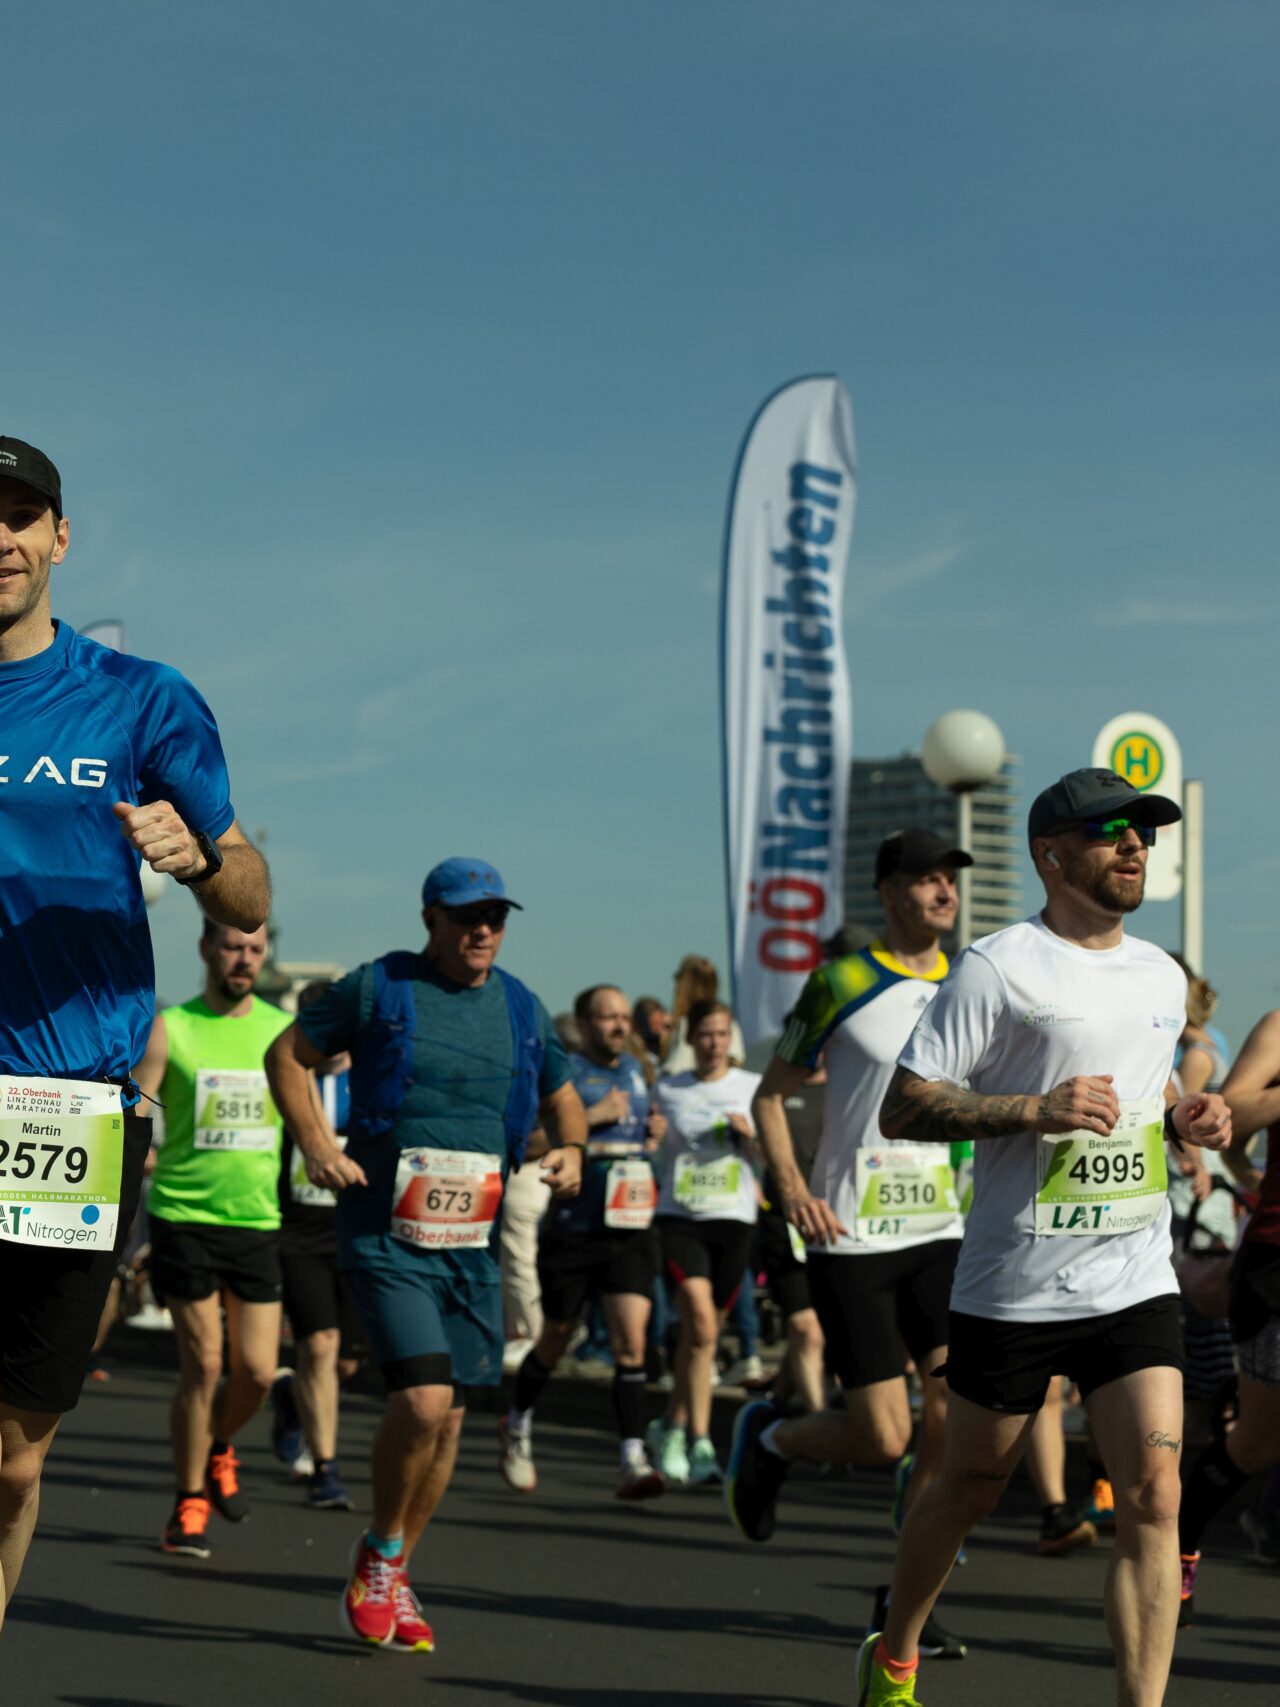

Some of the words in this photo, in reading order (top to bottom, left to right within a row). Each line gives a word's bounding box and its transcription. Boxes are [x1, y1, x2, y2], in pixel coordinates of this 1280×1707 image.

[1126, 746, 1149, 777] H
[23, 756, 108, 788] AG
[1032, 1014, 1055, 1025] ZMPT
[7, 1086, 21, 1096] 22.
[22, 1087, 62, 1099] Oberbank
[7, 1096, 26, 1104] LINZ
[30, 1098, 61, 1107] DONAU
[6, 1104, 61, 1114] MARATHON
[215, 1100, 264, 1119] 5815
[21, 1122, 61, 1137] Martin
[1088, 1139, 1132, 1150] Benjamin
[1068, 1152, 1144, 1184] 4995
[31, 1193, 107, 1202] HALBMARATHON
[426, 1189, 472, 1212] 673
[878, 1183, 936, 1204] 5310
[868, 1218, 901, 1235] LAT
[1051, 1205, 1103, 1229] LAT
[1106, 1213, 1152, 1229] Nitrogen
[26, 1222, 98, 1244] Nitrogen
[400, 1223, 480, 1244] Oberbank
